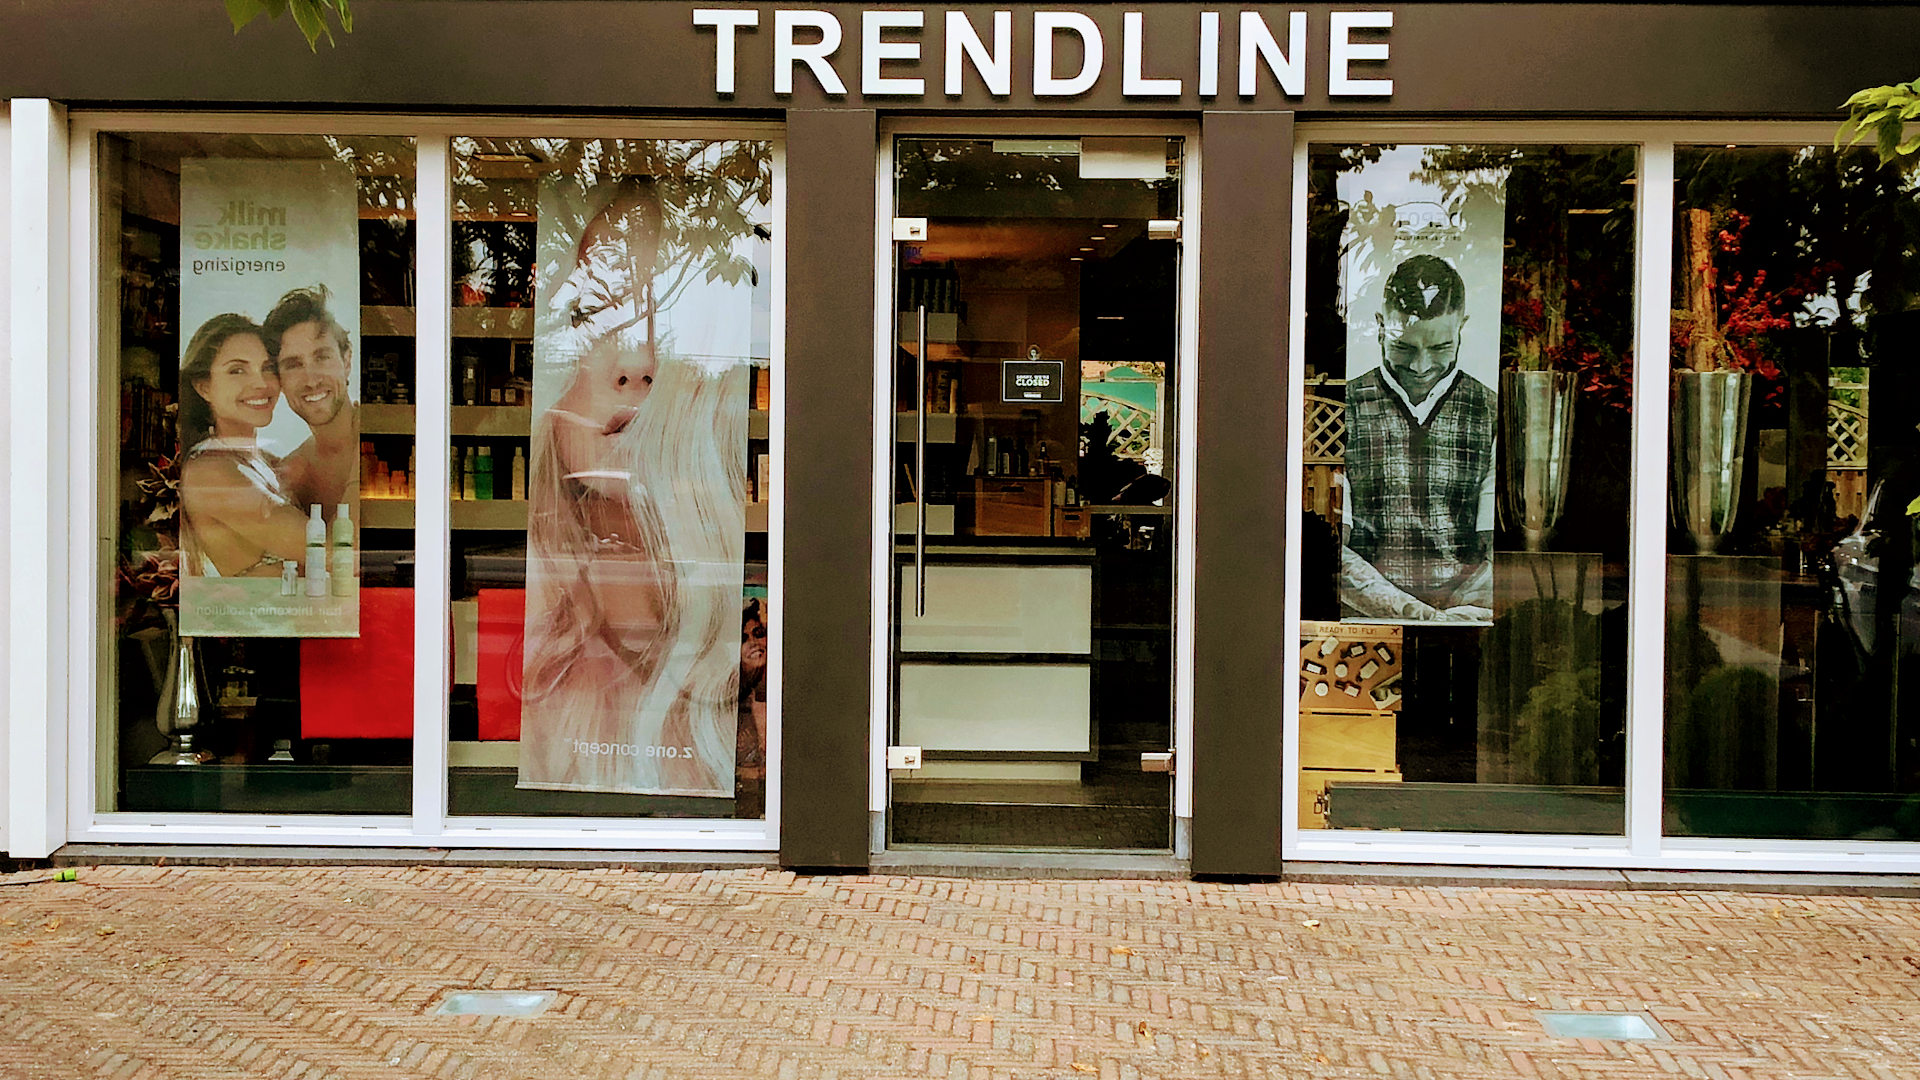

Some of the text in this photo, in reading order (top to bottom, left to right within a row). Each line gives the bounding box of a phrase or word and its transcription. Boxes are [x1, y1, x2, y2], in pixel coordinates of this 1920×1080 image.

[692, 8, 1395, 96] TRENDLINE
[1015, 379, 1050, 387] CLOSED
[1319, 626, 1344, 634] READY
